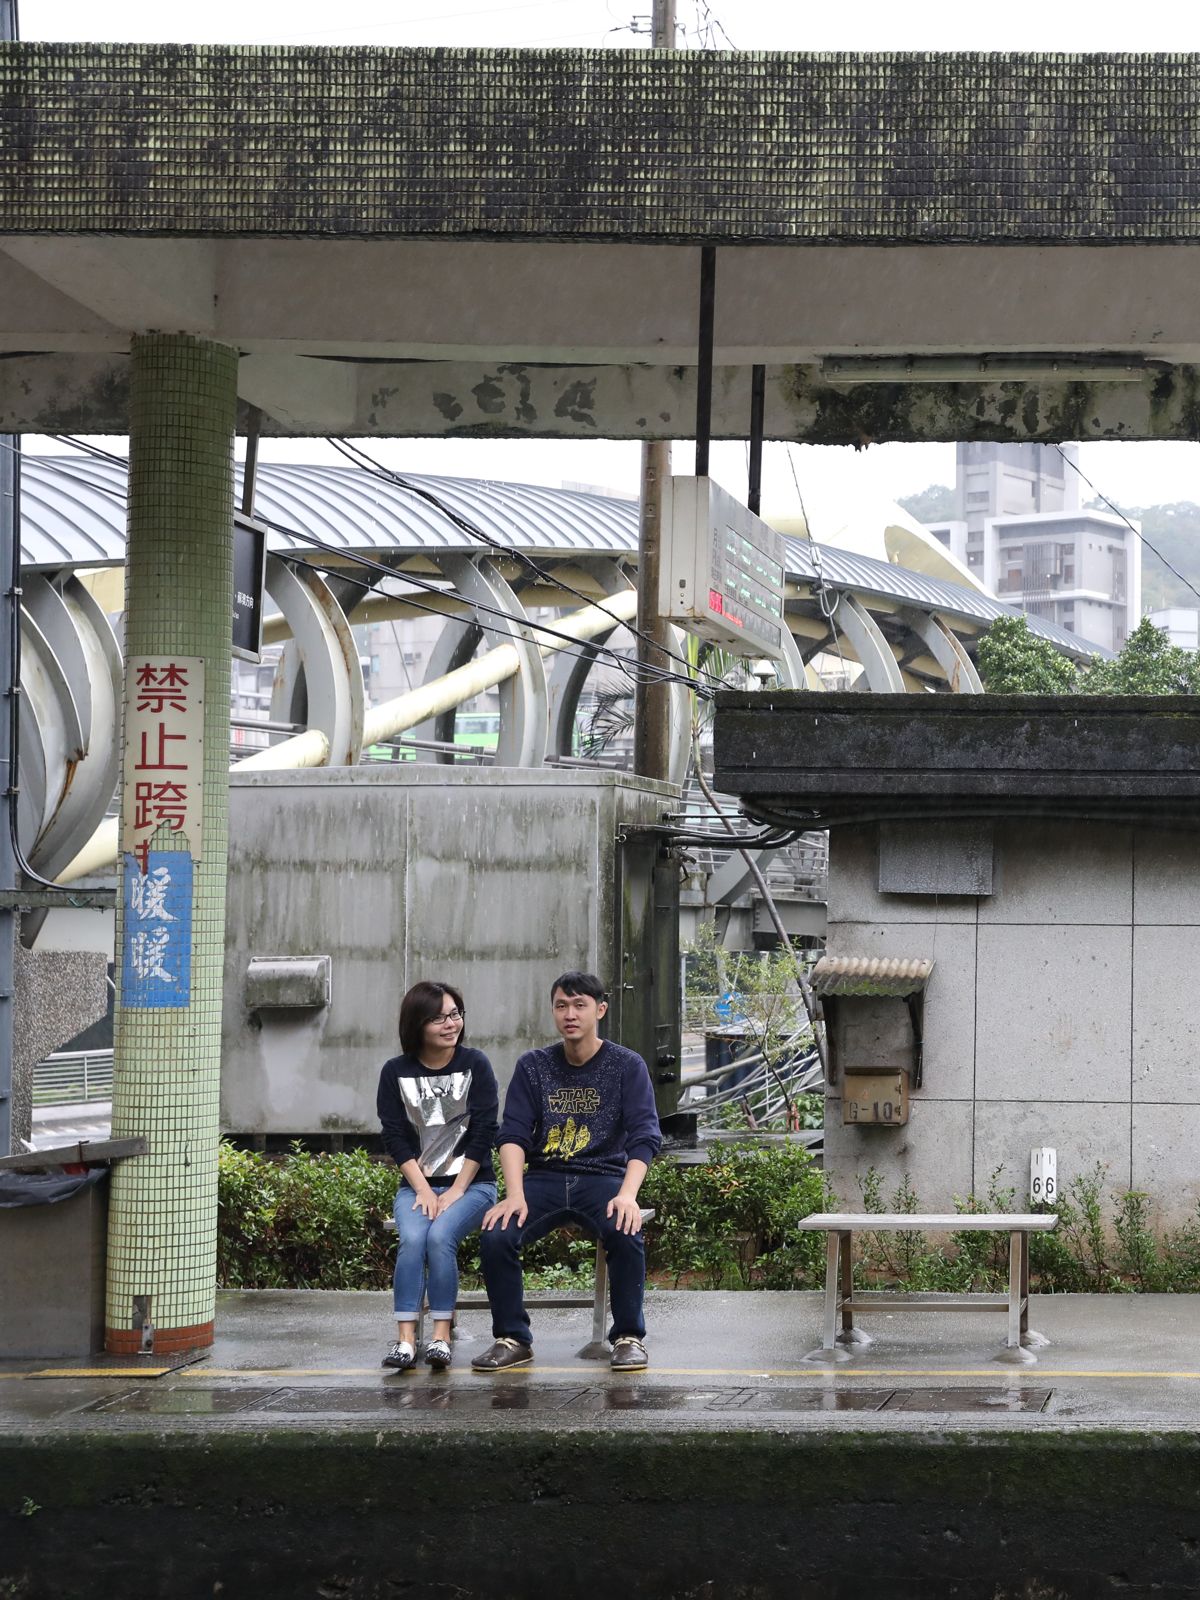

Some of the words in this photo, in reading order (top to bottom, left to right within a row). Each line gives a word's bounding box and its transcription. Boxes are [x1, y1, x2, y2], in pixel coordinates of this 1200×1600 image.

[134, 662, 189, 876] 禁止跨
[131, 866, 180, 982] 暖暖
[549, 1087, 600, 1101] STAR
[549, 1100, 600, 1113] WARS
